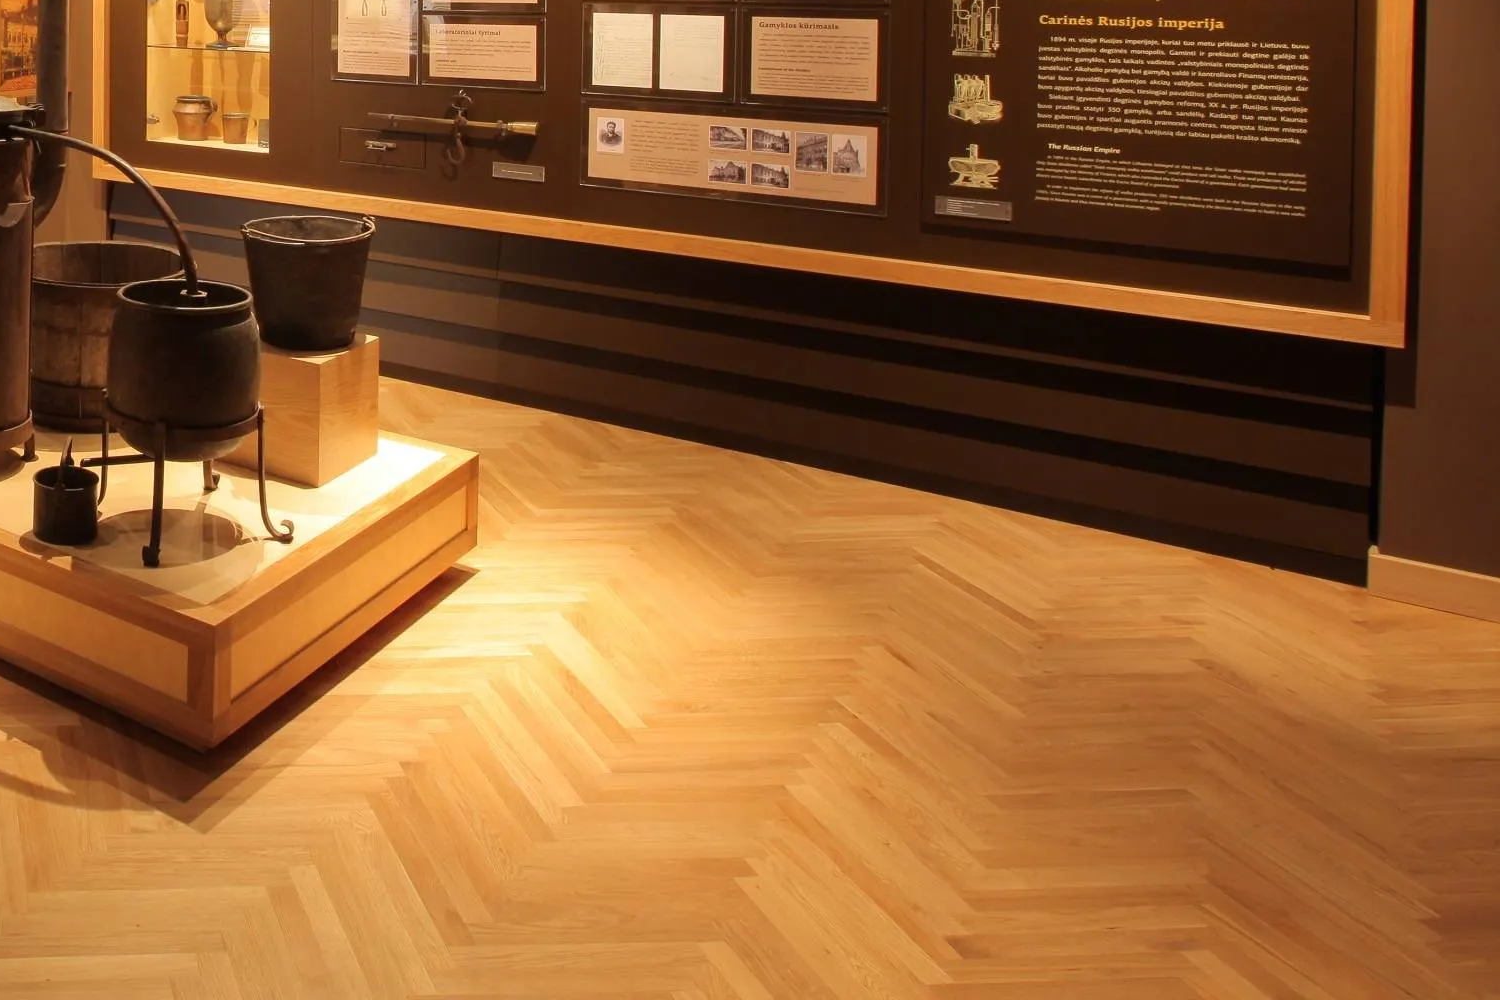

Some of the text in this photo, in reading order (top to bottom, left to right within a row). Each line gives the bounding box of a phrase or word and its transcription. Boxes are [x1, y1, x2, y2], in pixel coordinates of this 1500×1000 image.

[759, 21, 797, 31] Gamyklos
[1038, 14, 1225, 31] Carinės Rusijos imperija
[1062, 143, 1092, 151] Russian
[1093, 146, 1120, 154] Empire
